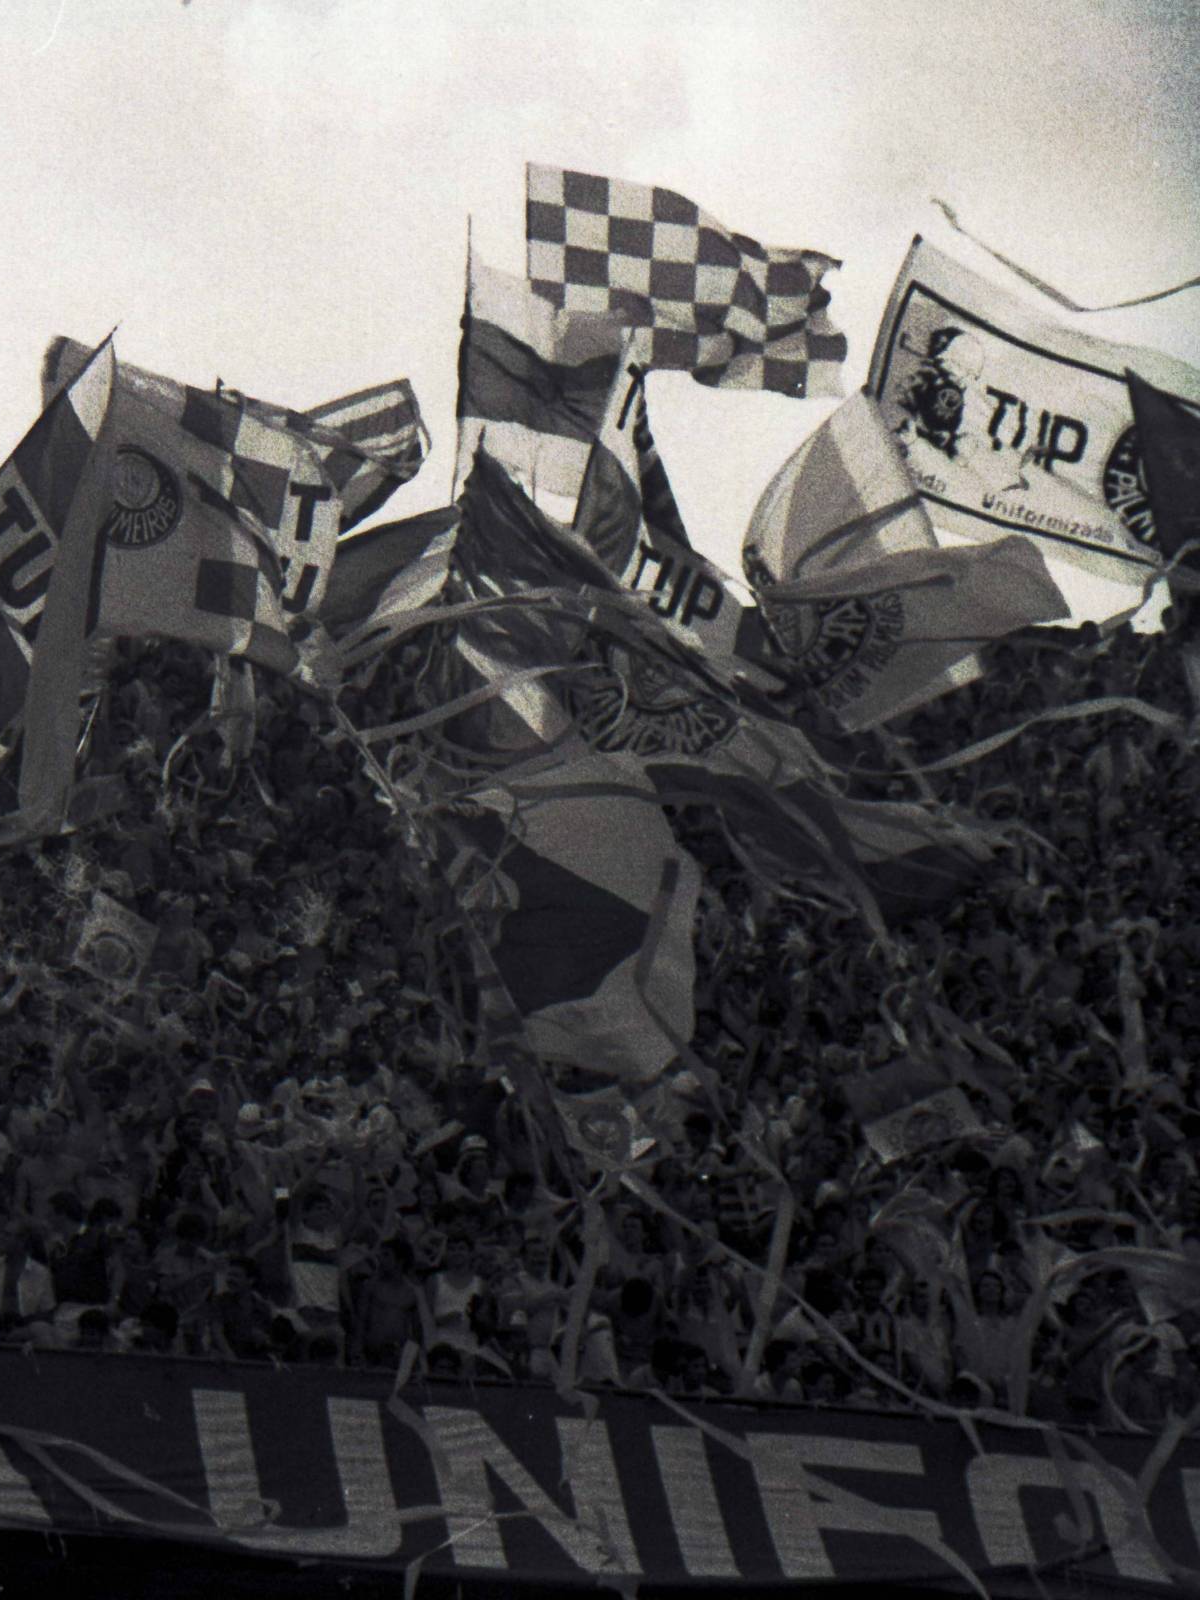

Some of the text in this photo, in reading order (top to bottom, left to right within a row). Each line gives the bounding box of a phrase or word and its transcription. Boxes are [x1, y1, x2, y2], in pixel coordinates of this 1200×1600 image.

[986, 386, 1088, 473] TUP
[1106, 468, 1157, 545] PALM
[630, 541, 724, 626] TUP
[192, 1388, 1200, 1584] UNIFO
